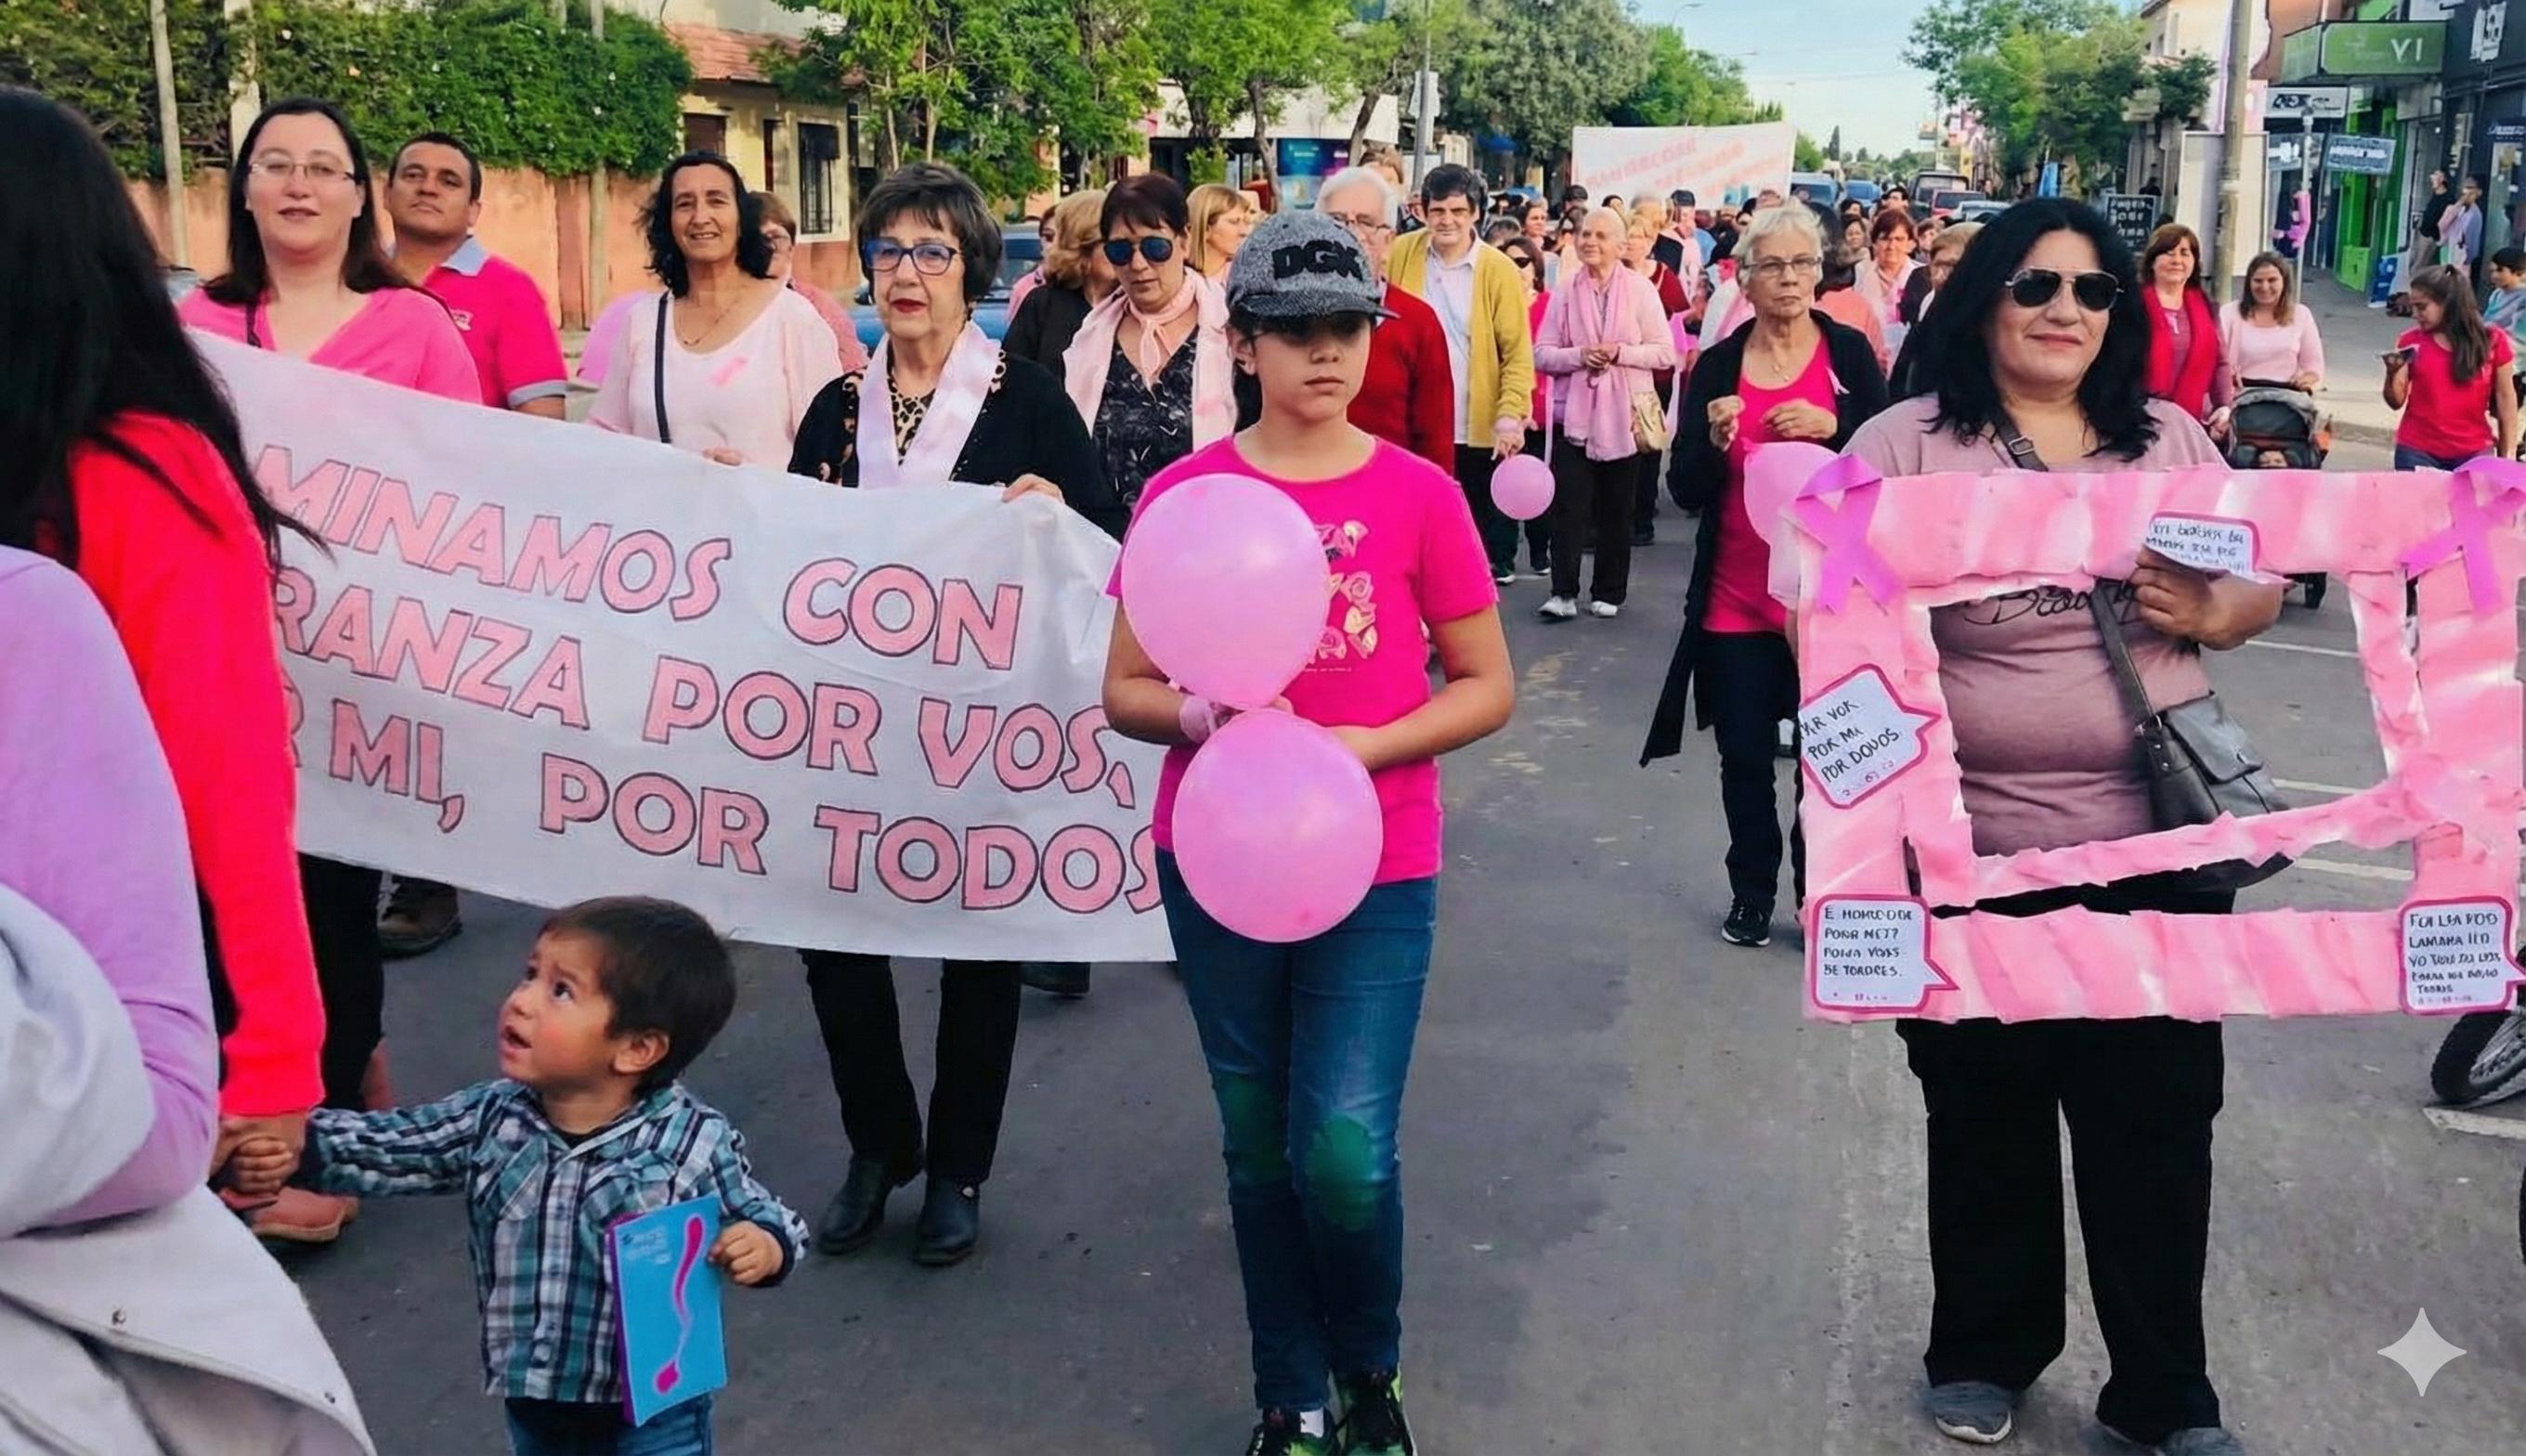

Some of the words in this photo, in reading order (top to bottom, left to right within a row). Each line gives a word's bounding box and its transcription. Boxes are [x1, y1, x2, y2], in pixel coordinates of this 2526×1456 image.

[254, 444, 733, 621] MINAMOS
[782, 556, 1023, 671] CON
[274, 565, 592, 731] RANZA
[643, 654, 883, 776] POR
[917, 696, 1137, 809] VOS,
[329, 696, 466, 835] MI,
[539, 750, 770, 876] POR
[814, 804, 1165, 915] TODOS
